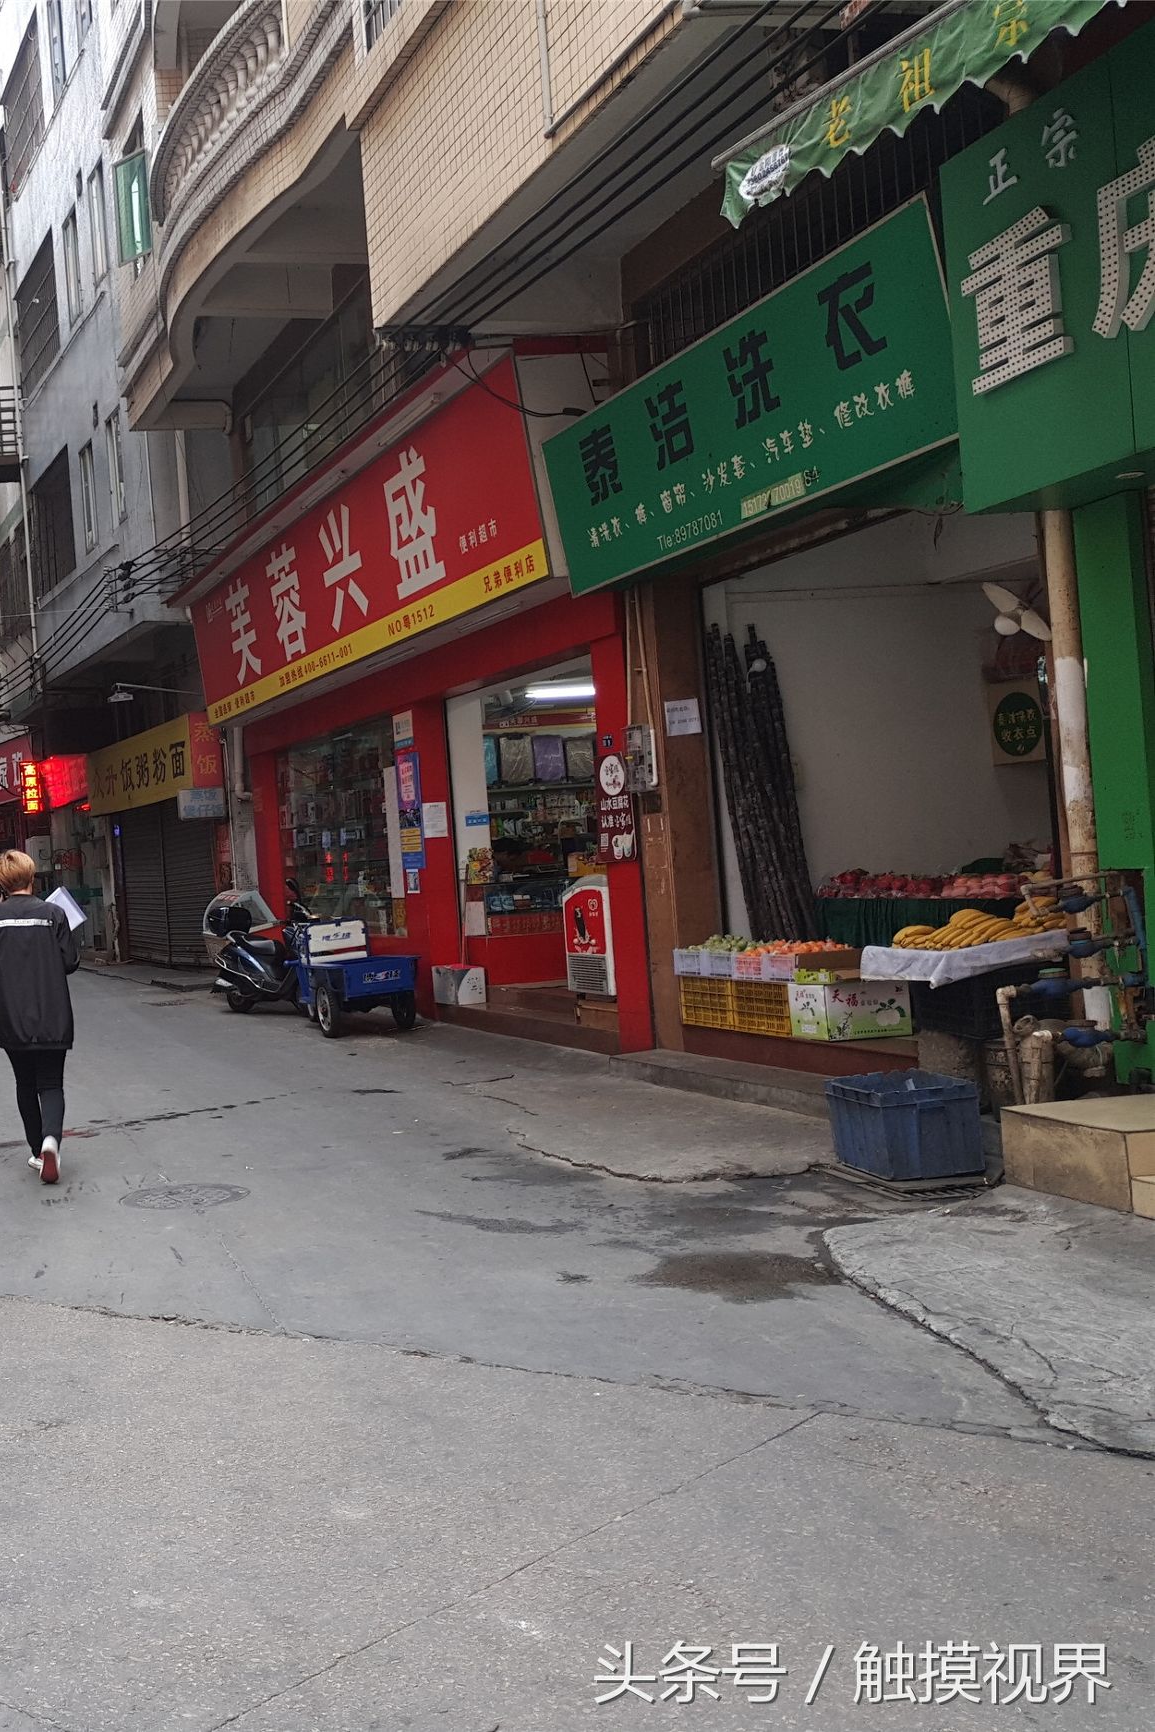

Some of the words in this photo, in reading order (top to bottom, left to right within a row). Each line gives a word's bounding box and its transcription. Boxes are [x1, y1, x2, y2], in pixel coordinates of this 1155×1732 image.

[983, 108, 1078, 206] 正宗
[579, 260, 888, 507] 泰洁洗衣
[459, 518, 498, 555] 便利超市
[656, 510, 724, 551] Tle:89787081
[225, 446, 446, 686] 芙蓉兴盛
[482, 554, 536, 594] 兄弟便利店
[23, 764, 39, 811] 高原拉面
[600, 794, 630, 811] 山水豆腐花
